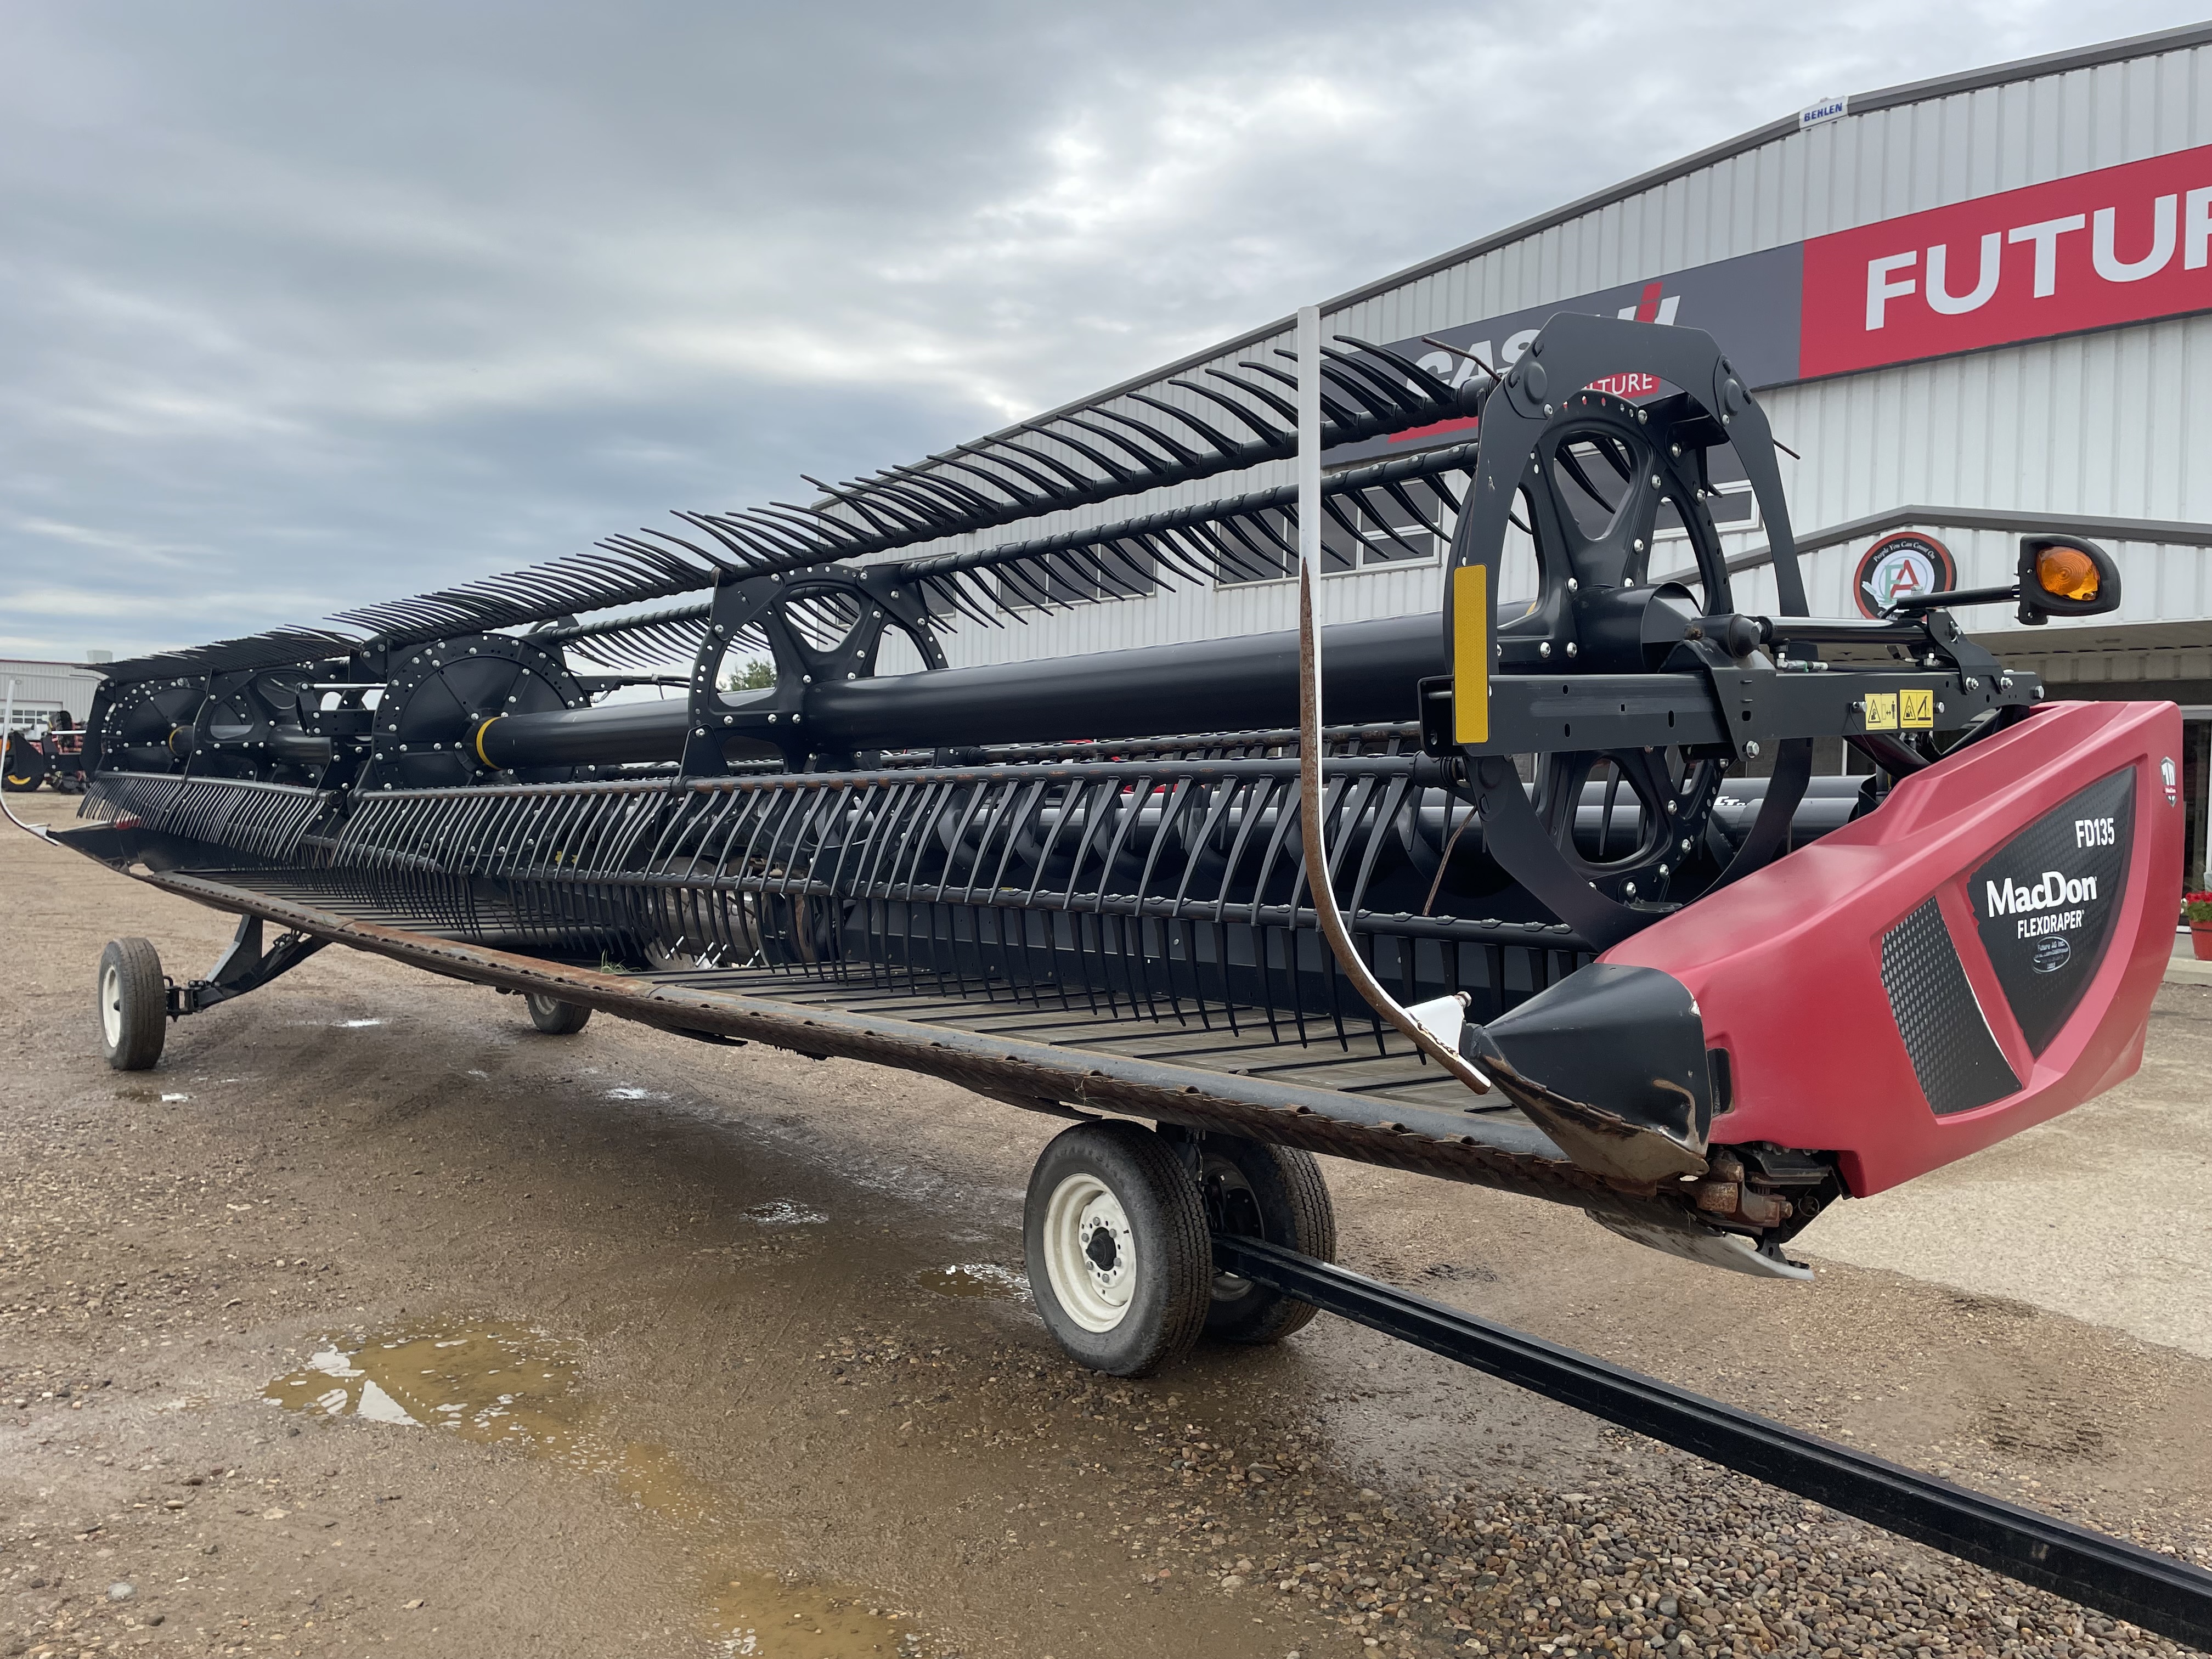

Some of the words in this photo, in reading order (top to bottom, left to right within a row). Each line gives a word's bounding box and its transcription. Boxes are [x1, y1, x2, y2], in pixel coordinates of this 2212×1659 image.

[1804, 102, 1842, 122] BEHLEN
[1873, 547, 1889, 562] People
[1913, 542, 1929, 553] Count
[1927, 550, 1936, 560] On
[2075, 817, 2115, 848] FD135
[1986, 871, 2097, 918] MacDon
[2017, 910, 2083, 939] FLEXDRAPER
